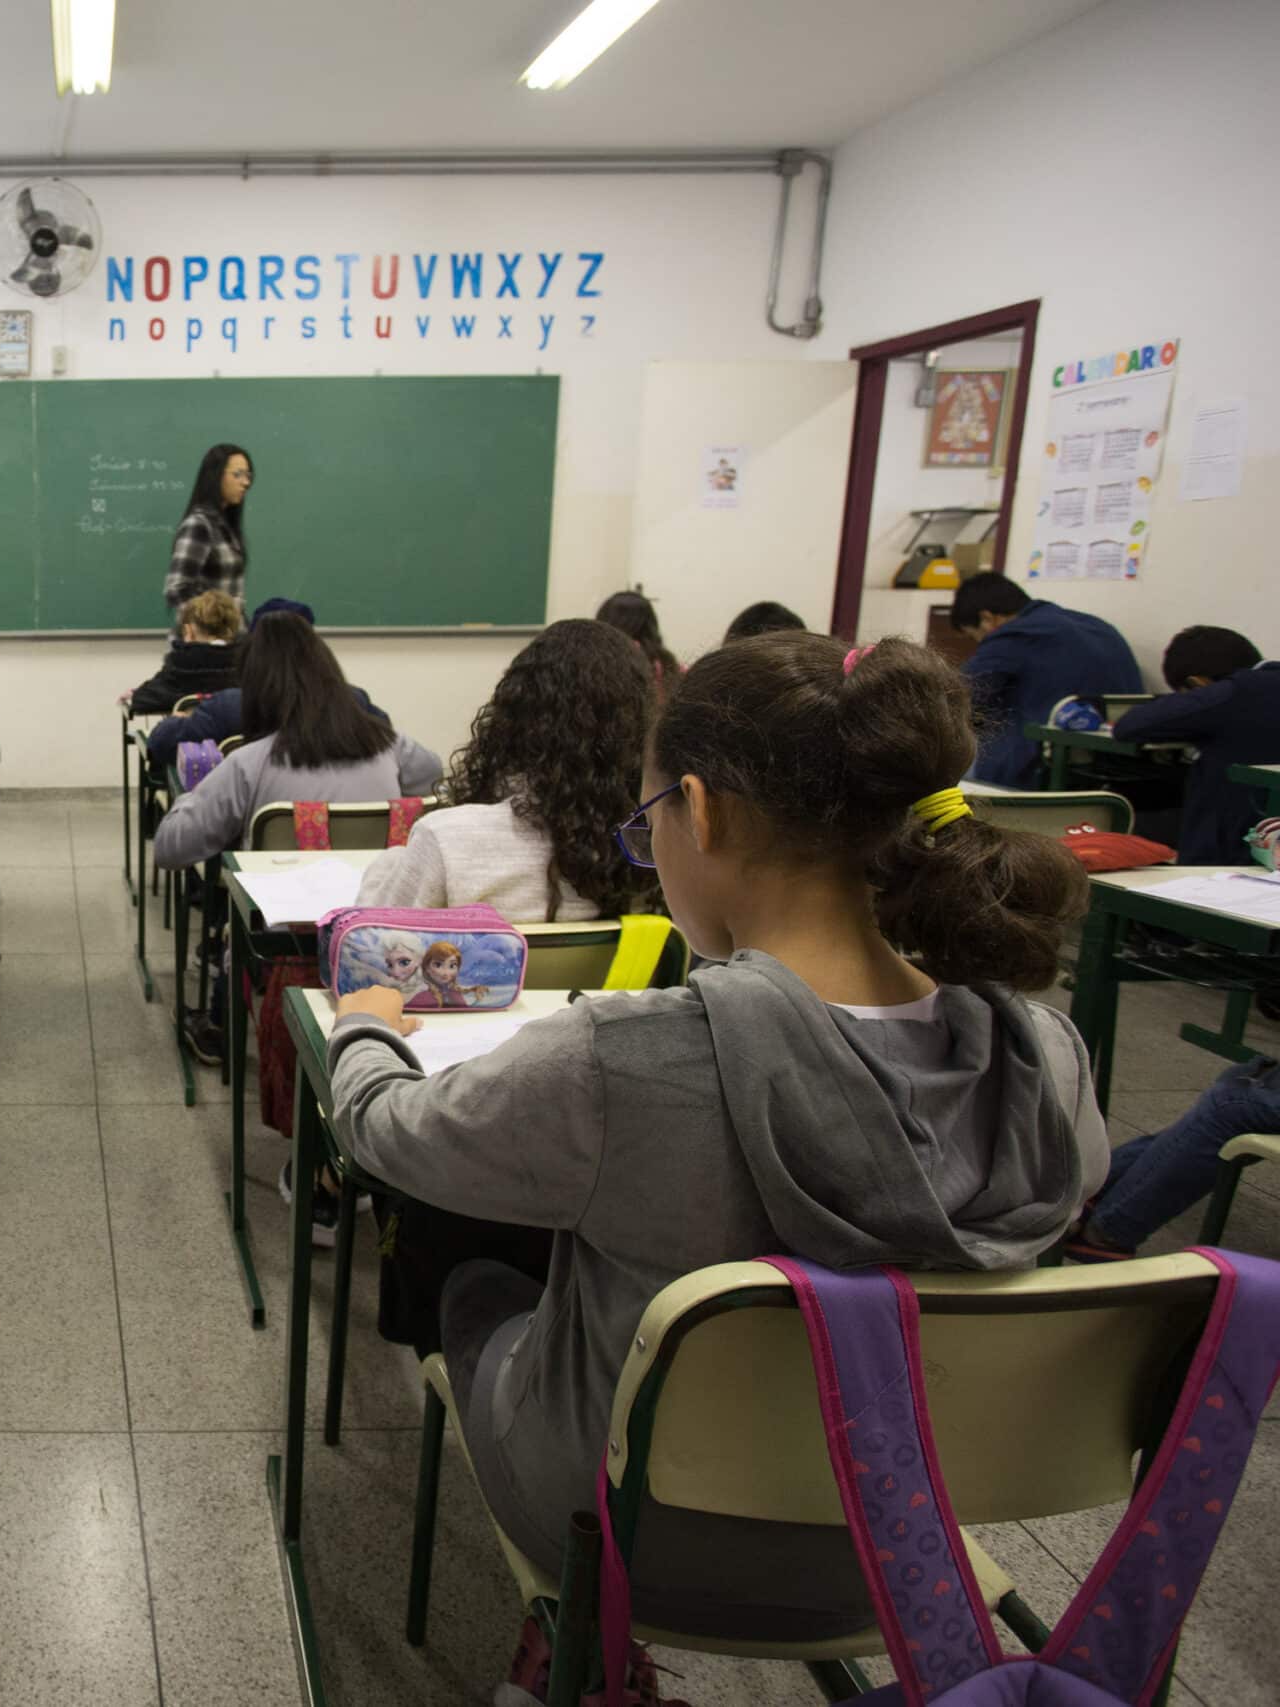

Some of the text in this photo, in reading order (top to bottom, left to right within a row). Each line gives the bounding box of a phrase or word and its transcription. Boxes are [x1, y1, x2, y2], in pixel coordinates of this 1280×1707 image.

[107, 256, 134, 303] N
[144, 256, 172, 303] O
[183, 256, 209, 302] P
[219, 256, 247, 301] Q
[258, 255, 285, 301] R
[295, 255, 321, 300] S
[335, 254, 359, 299] T
[371, 254, 400, 301] U
[413, 254, 438, 299] V
[451, 252, 483, 299] W
[496, 253, 523, 299] X
[537, 252, 563, 298] Y
[576, 252, 605, 298] Z
